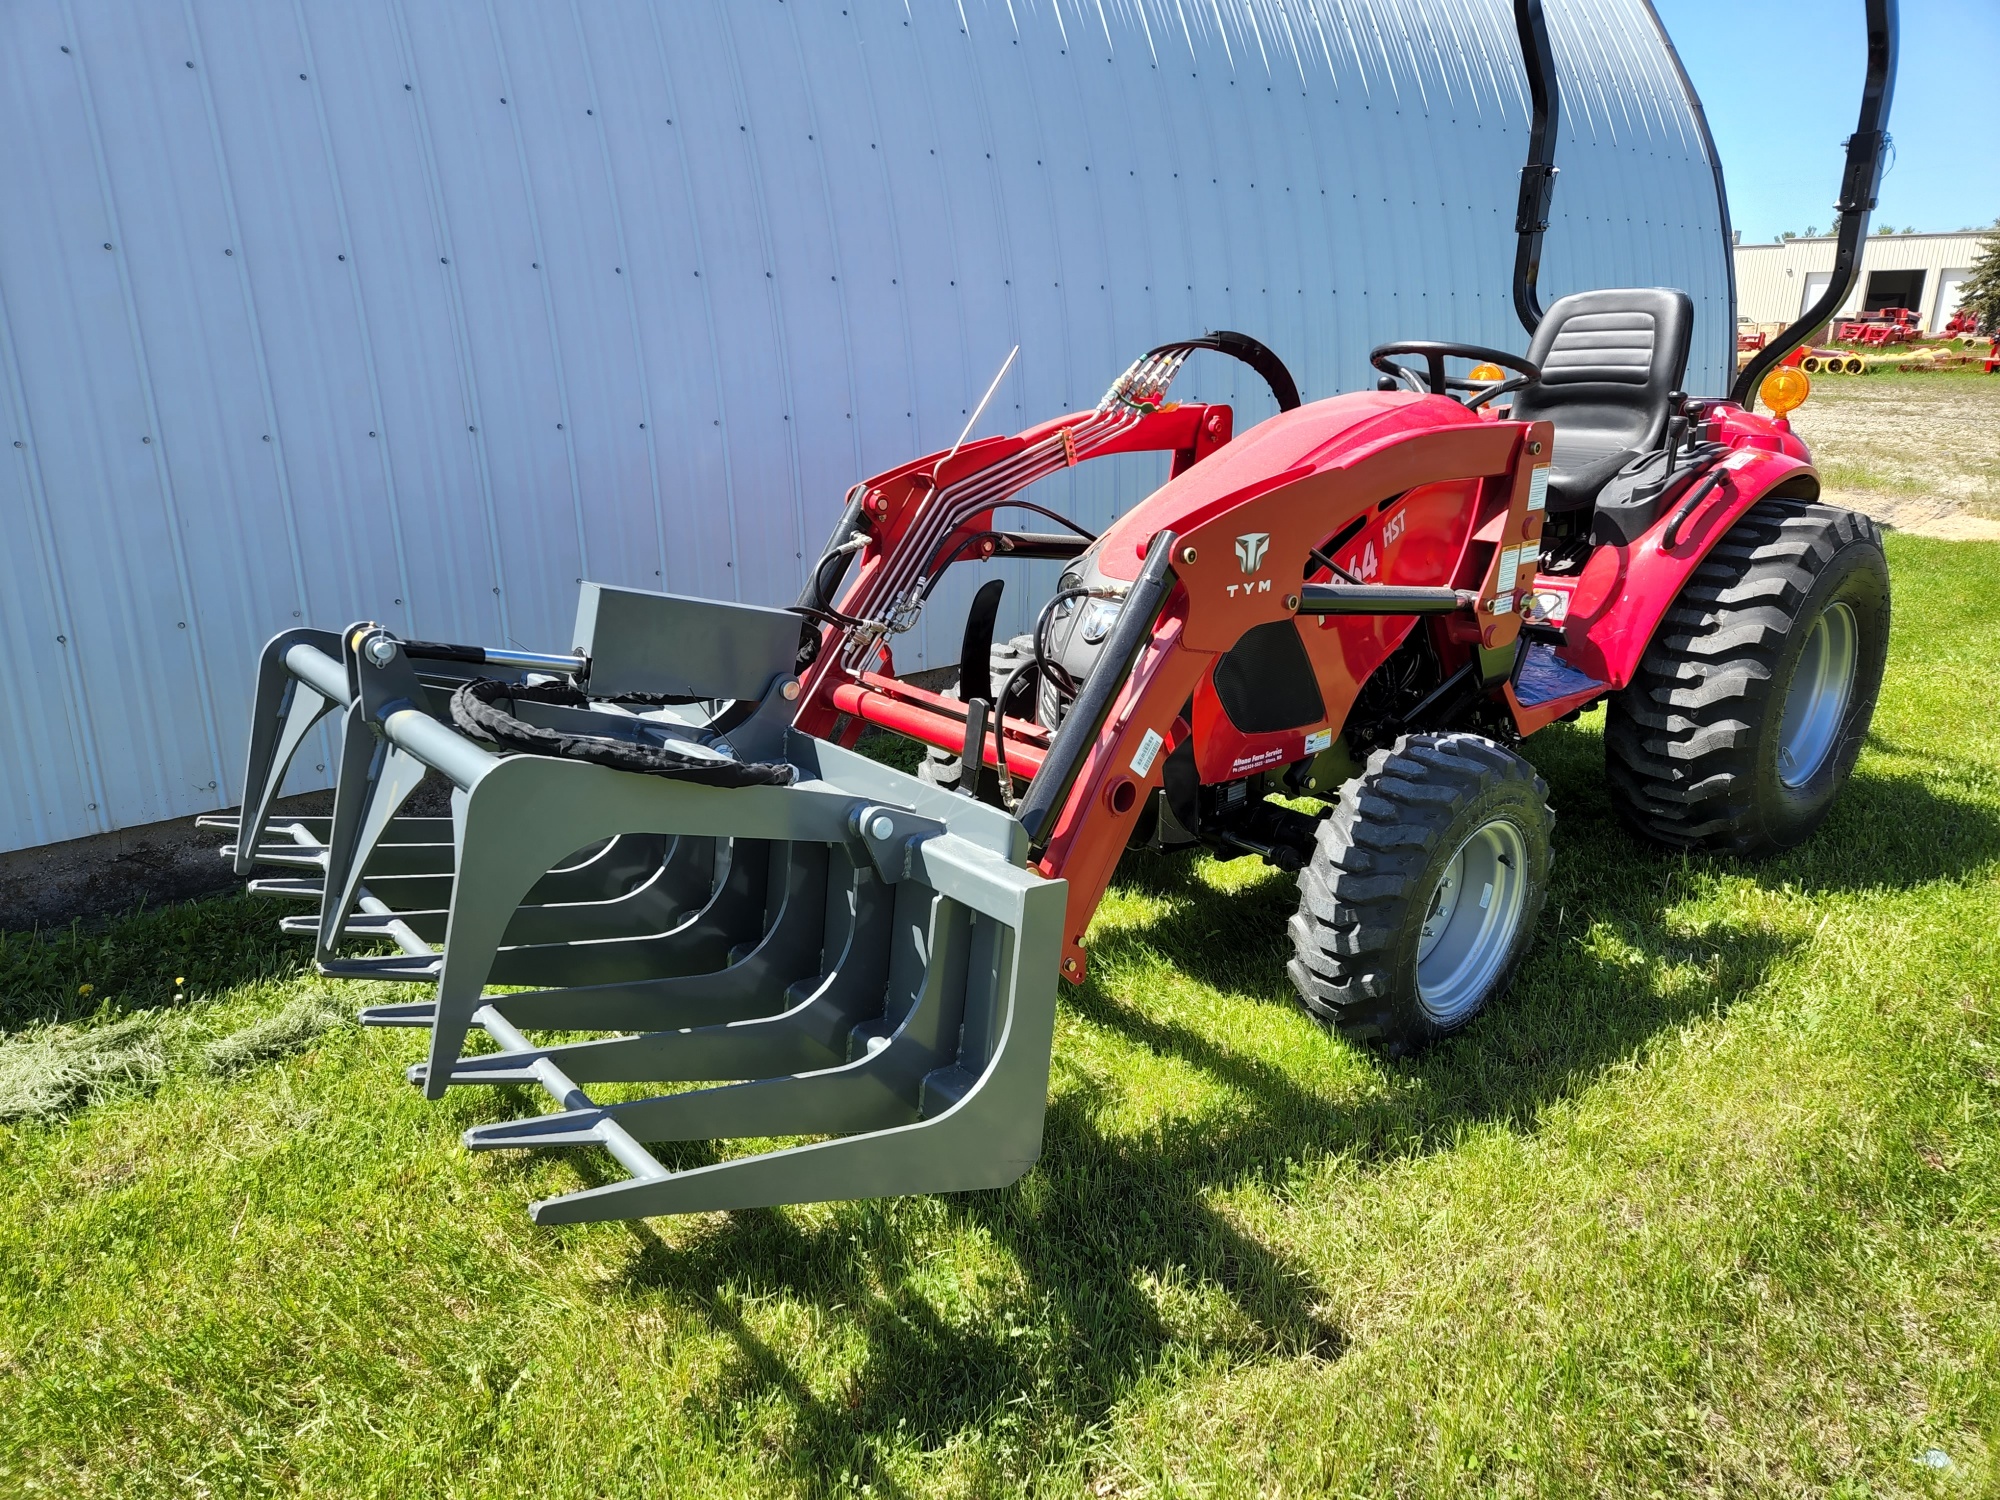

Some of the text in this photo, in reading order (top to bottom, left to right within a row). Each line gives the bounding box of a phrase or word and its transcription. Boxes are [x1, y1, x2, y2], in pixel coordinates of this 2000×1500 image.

[1383, 508, 1406, 548] HST
[1227, 579, 1271, 598] TYM
[1265, 748, 1282, 758] Service
